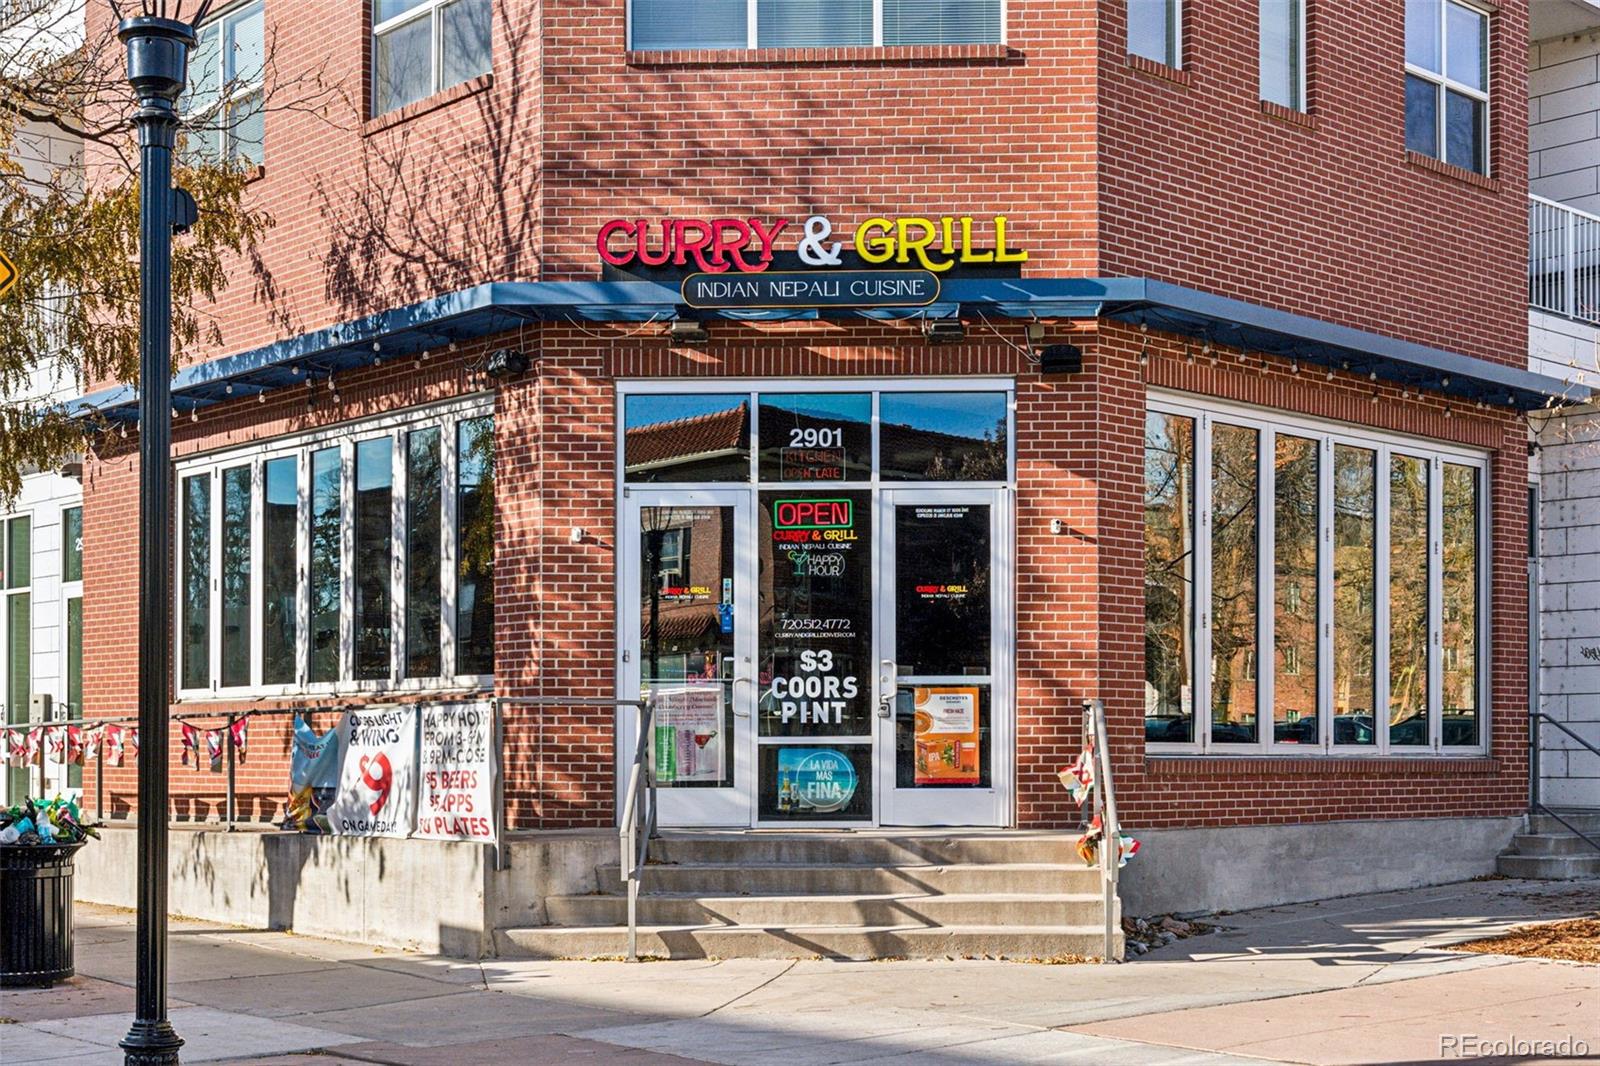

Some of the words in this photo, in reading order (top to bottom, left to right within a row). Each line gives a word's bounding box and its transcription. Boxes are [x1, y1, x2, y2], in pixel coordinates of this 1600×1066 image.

[596, 217, 789, 273] CURRY
[798, 216, 842, 265] &
[854, 217, 1028, 272] GRILL
[697, 281, 759, 298] INDIAN
[770, 281, 840, 298] NEPALI
[849, 280, 925, 297] CUISINE
[789, 428, 843, 447] 2901
[815, 467, 841, 479] LATE
[779, 502, 848, 525] OPEN
[773, 530, 810, 542] CURRY
[812, 530, 822, 541] &
[824, 530, 858, 542] GRILL
[807, 554, 843, 565] HAPPY
[809, 565, 840, 576] HOUR
[947, 585, 969, 593] GRILL
[800, 650, 833, 672] $3
[772, 676, 858, 698] COORS
[424, 712, 455, 728] HAPPY
[781, 702, 847, 723] PINT
[350, 729, 359, 746] &
[810, 760, 820, 769] LA
[821, 760, 838, 769] VIDA
[807, 782, 841, 799] FINA
[435, 816, 490, 836] PLATES
